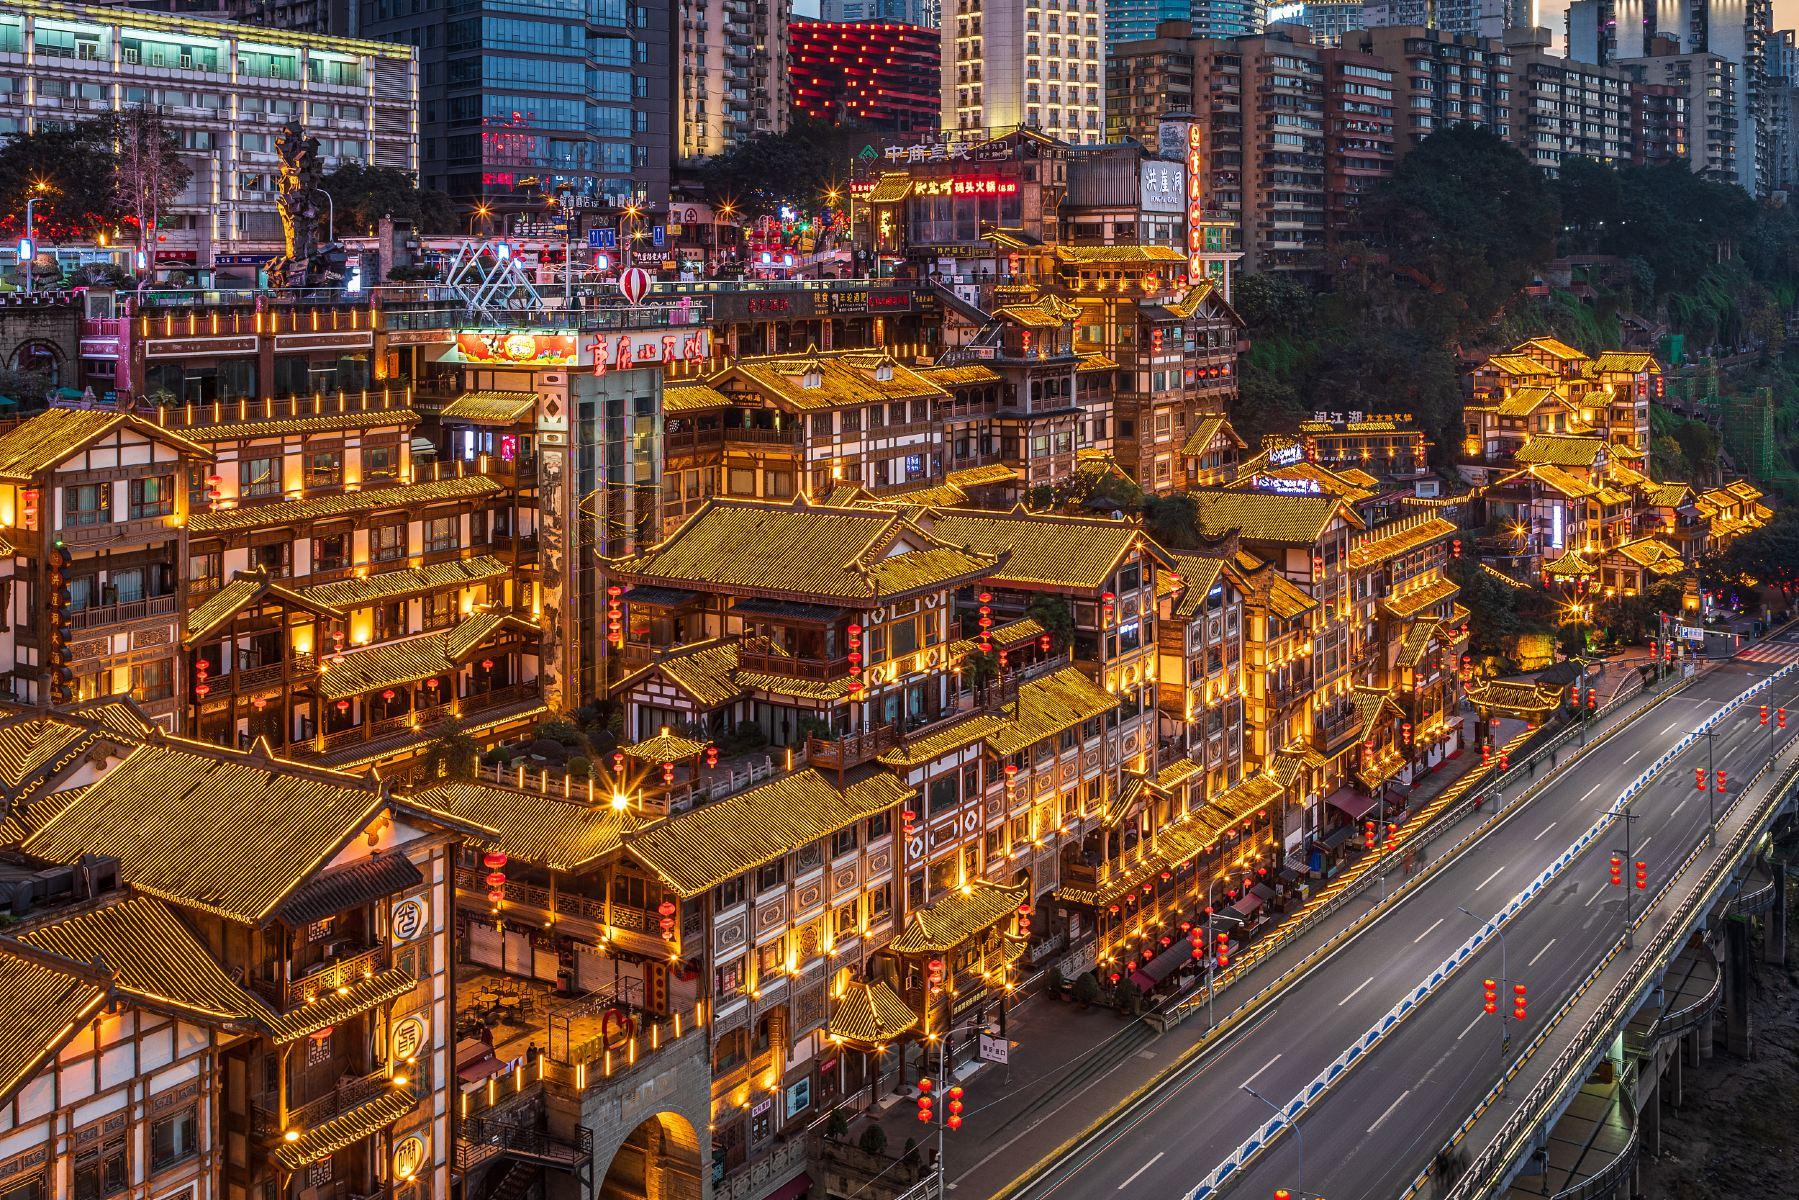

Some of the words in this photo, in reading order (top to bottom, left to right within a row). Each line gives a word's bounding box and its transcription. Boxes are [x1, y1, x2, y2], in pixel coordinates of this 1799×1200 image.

[1145, 167, 1182, 194] 洪崖洞
[586, 331, 704, 377] 重庆小天鹅
